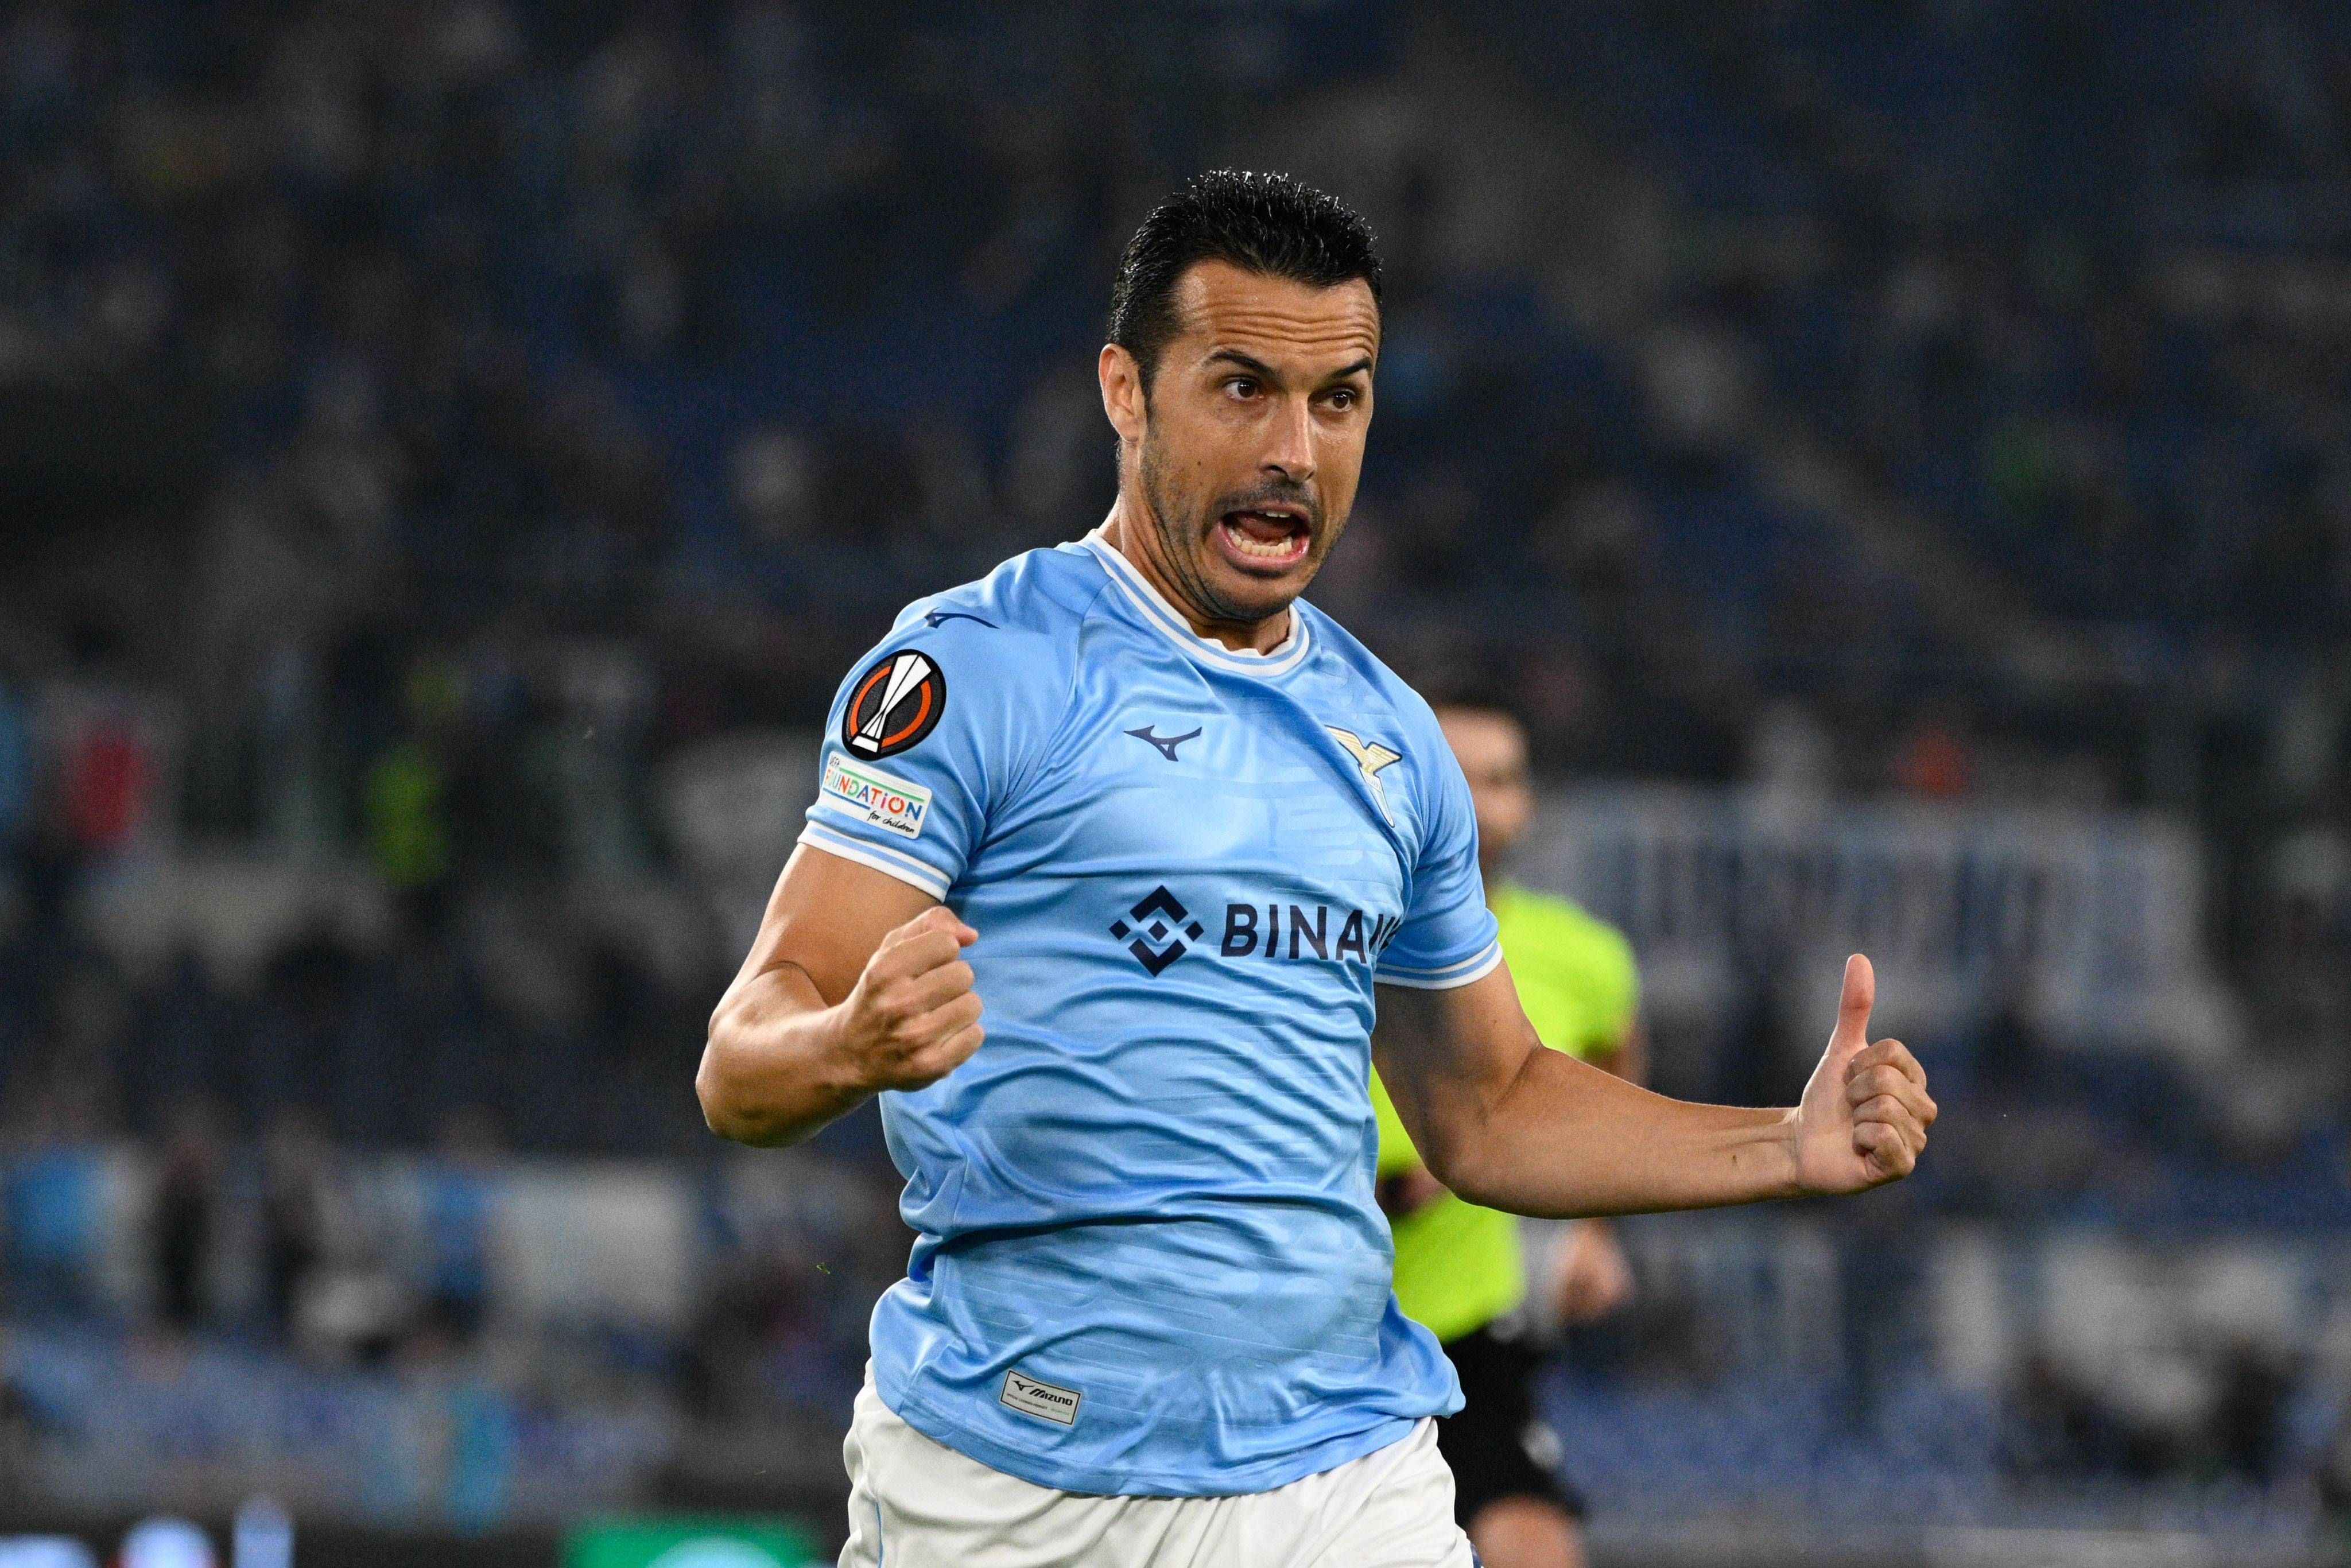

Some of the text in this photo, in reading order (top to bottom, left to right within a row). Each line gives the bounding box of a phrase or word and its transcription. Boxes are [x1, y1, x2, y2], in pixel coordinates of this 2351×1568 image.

[824, 769, 923, 821] FOUNDATION
[867, 810, 914, 833] for children
[1029, 1388, 1073, 1406] MIZUNO
